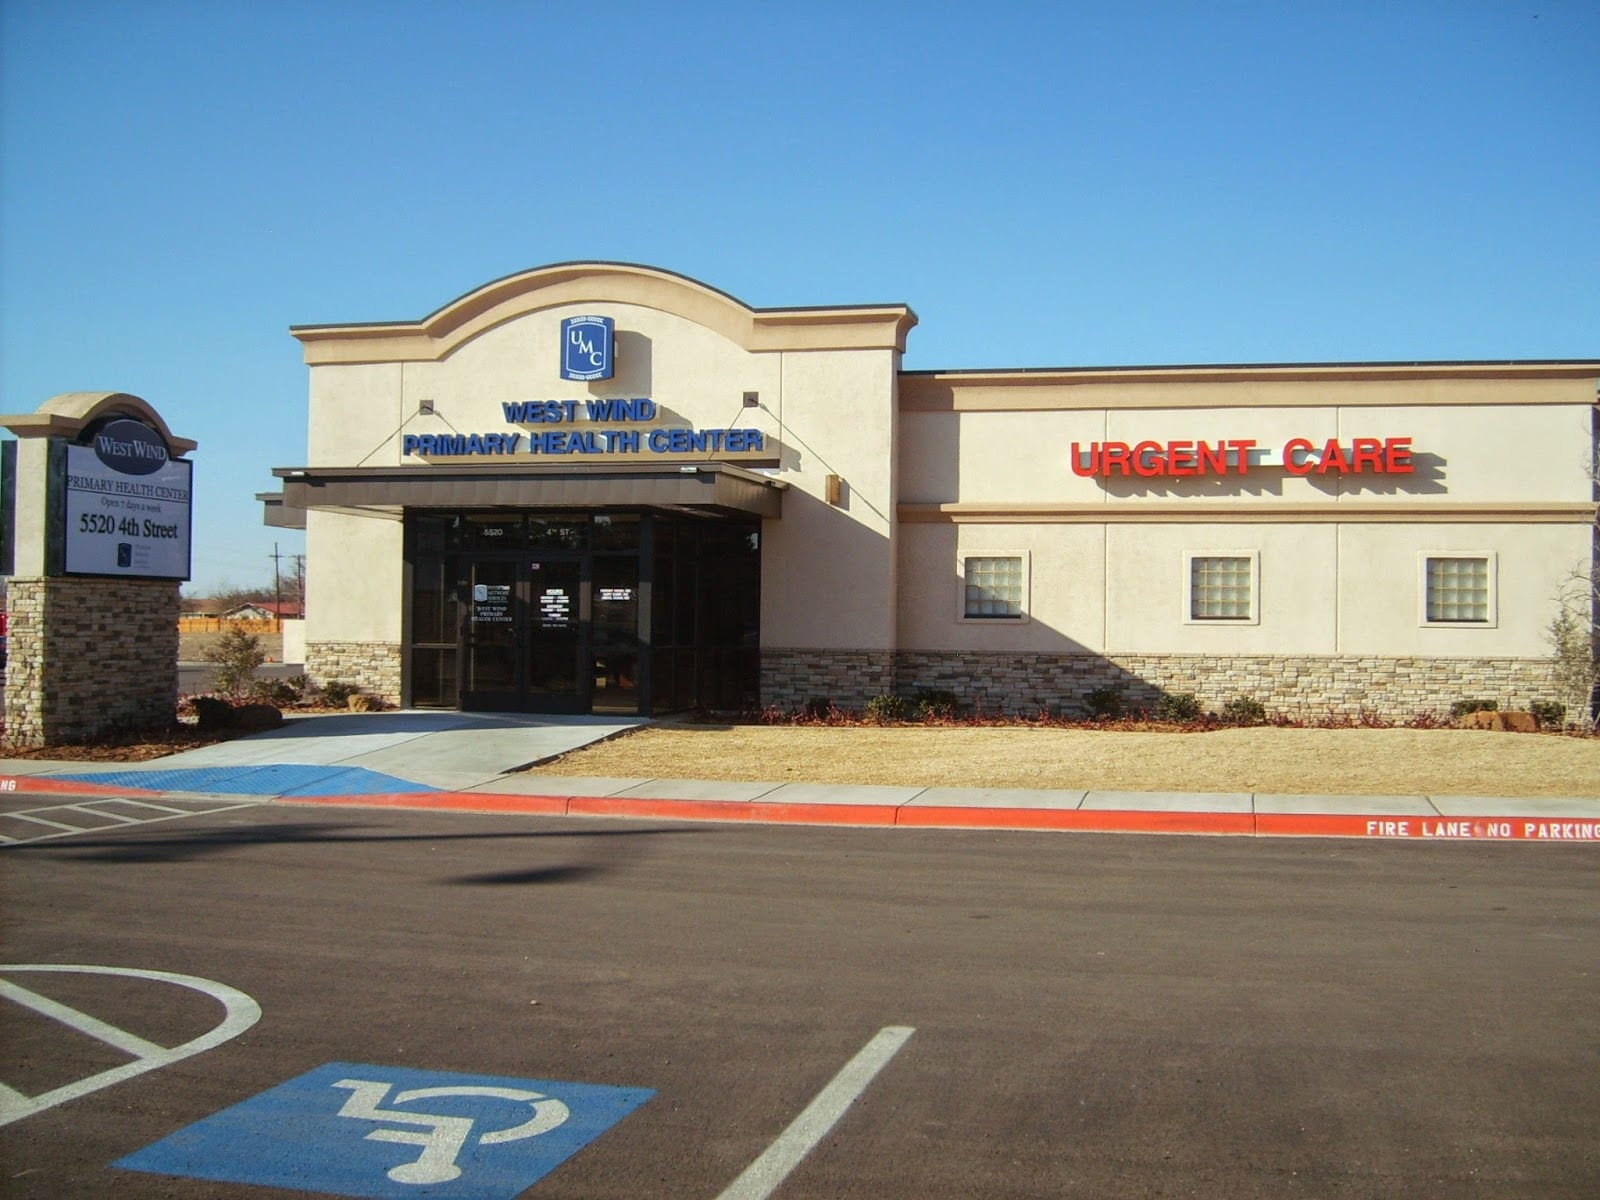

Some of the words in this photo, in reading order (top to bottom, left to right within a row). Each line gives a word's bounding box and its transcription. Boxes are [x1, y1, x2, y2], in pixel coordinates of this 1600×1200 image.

[571, 331, 602, 366] UMC
[503, 400, 580, 424] WEST
[586, 398, 656, 422] WIND
[403, 432, 521, 456] PRIMARY
[529, 430, 642, 454] HEALTH
[648, 428, 764, 453] CENTER
[1071, 439, 1256, 477] URGENT
[1282, 437, 1415, 474] CARE
[67, 475, 114, 492] PRIMARY
[116, 481, 153, 497] HEALTH
[155, 486, 189, 501] CENTER
[80, 513, 115, 534] 5520
[118, 515, 140, 537] 4th
[143, 519, 178, 539] Street
[483, 528, 503, 536] 5520
[1367, 821, 1408, 836] FIRE
[1422, 822, 1471, 837] LANE
[1487, 823, 1511, 837] NO
